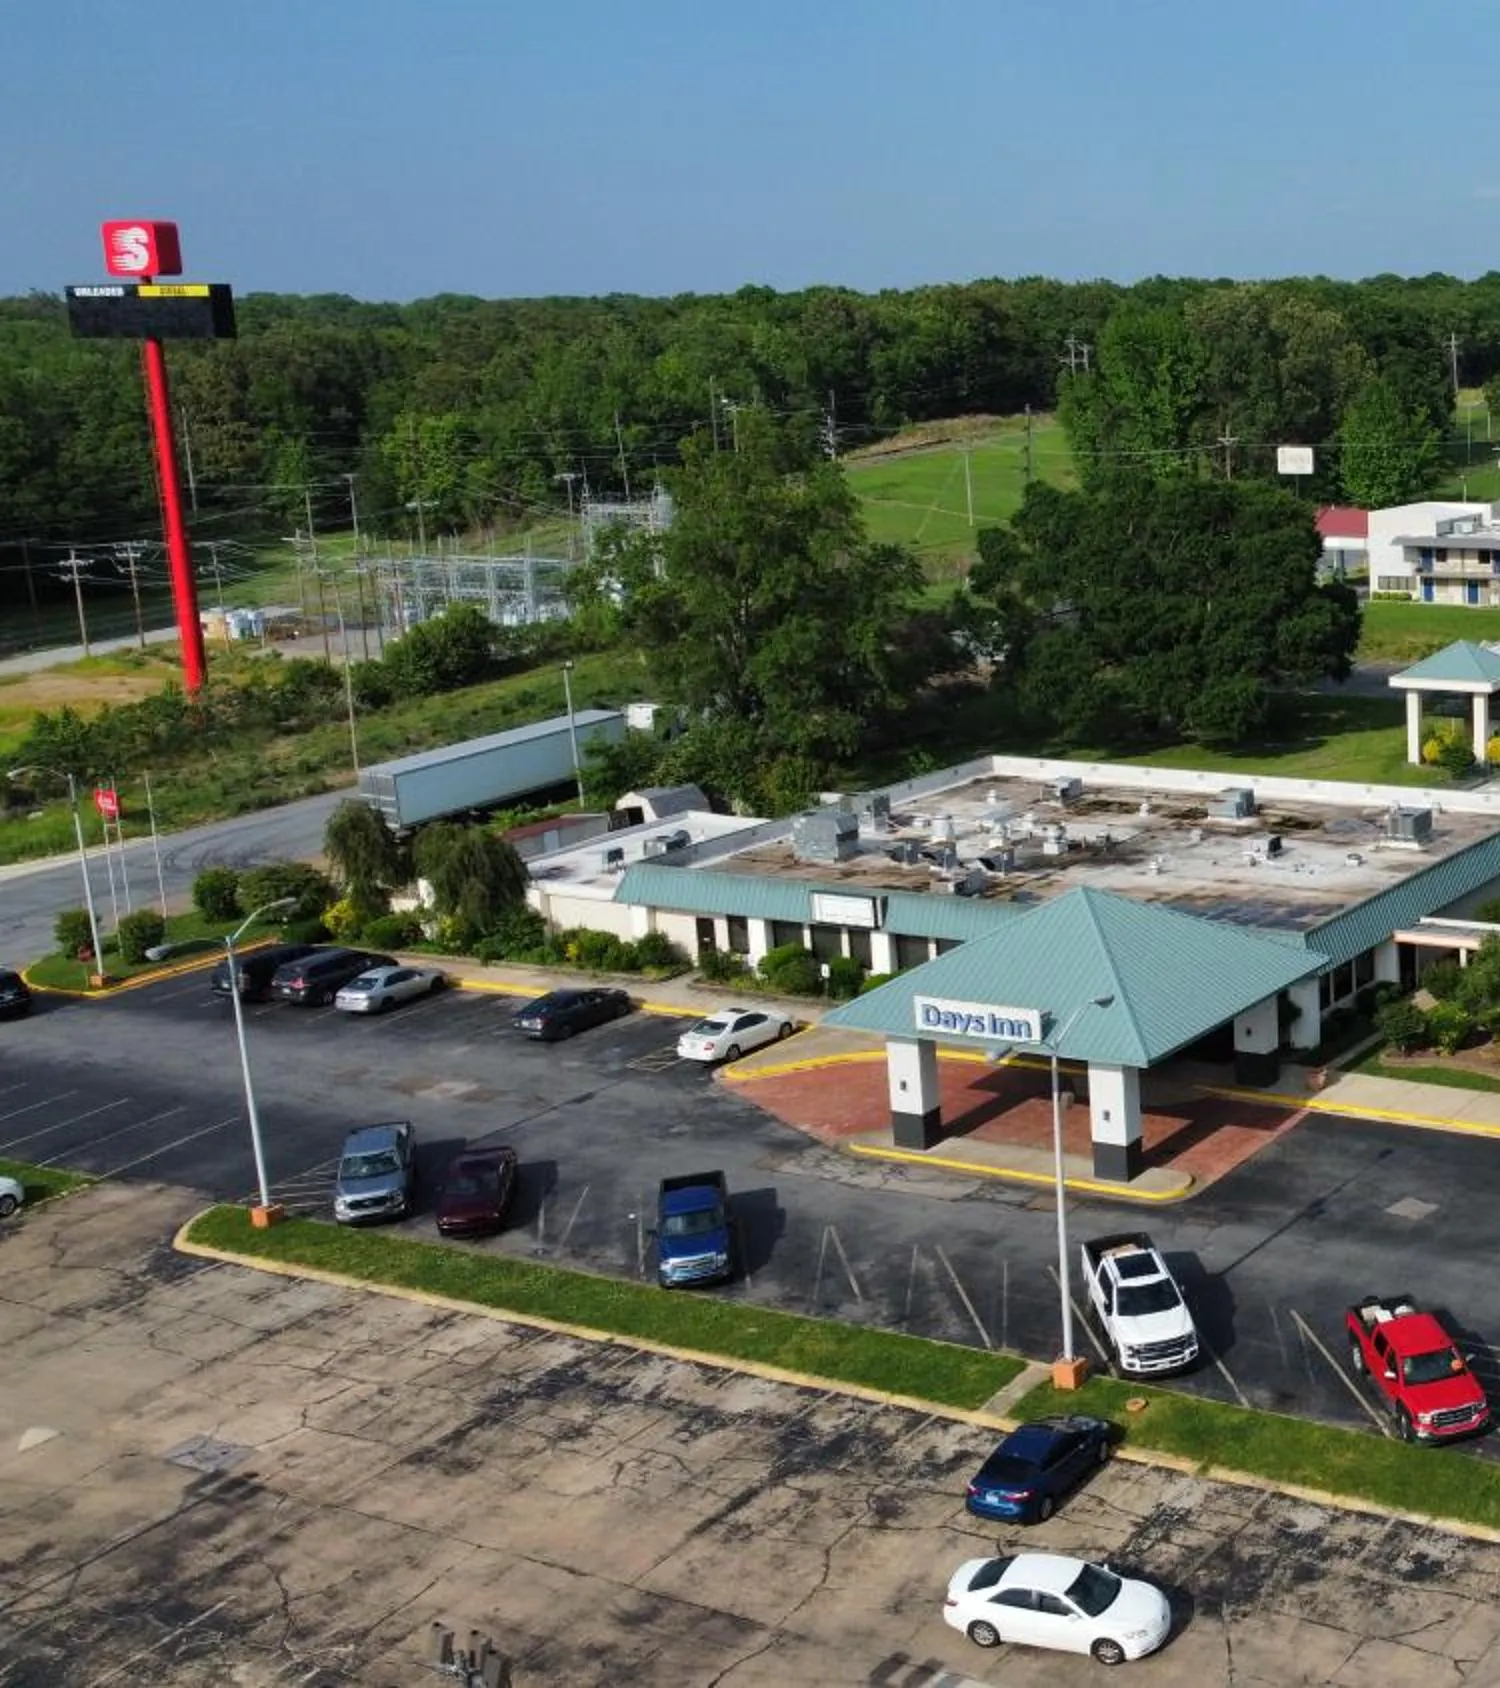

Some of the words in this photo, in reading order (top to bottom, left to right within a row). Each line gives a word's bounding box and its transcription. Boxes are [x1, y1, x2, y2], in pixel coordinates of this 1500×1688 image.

[112, 227, 149, 271] S
[922, 1003, 985, 1033] Days
[988, 1012, 1033, 1038] Inn
